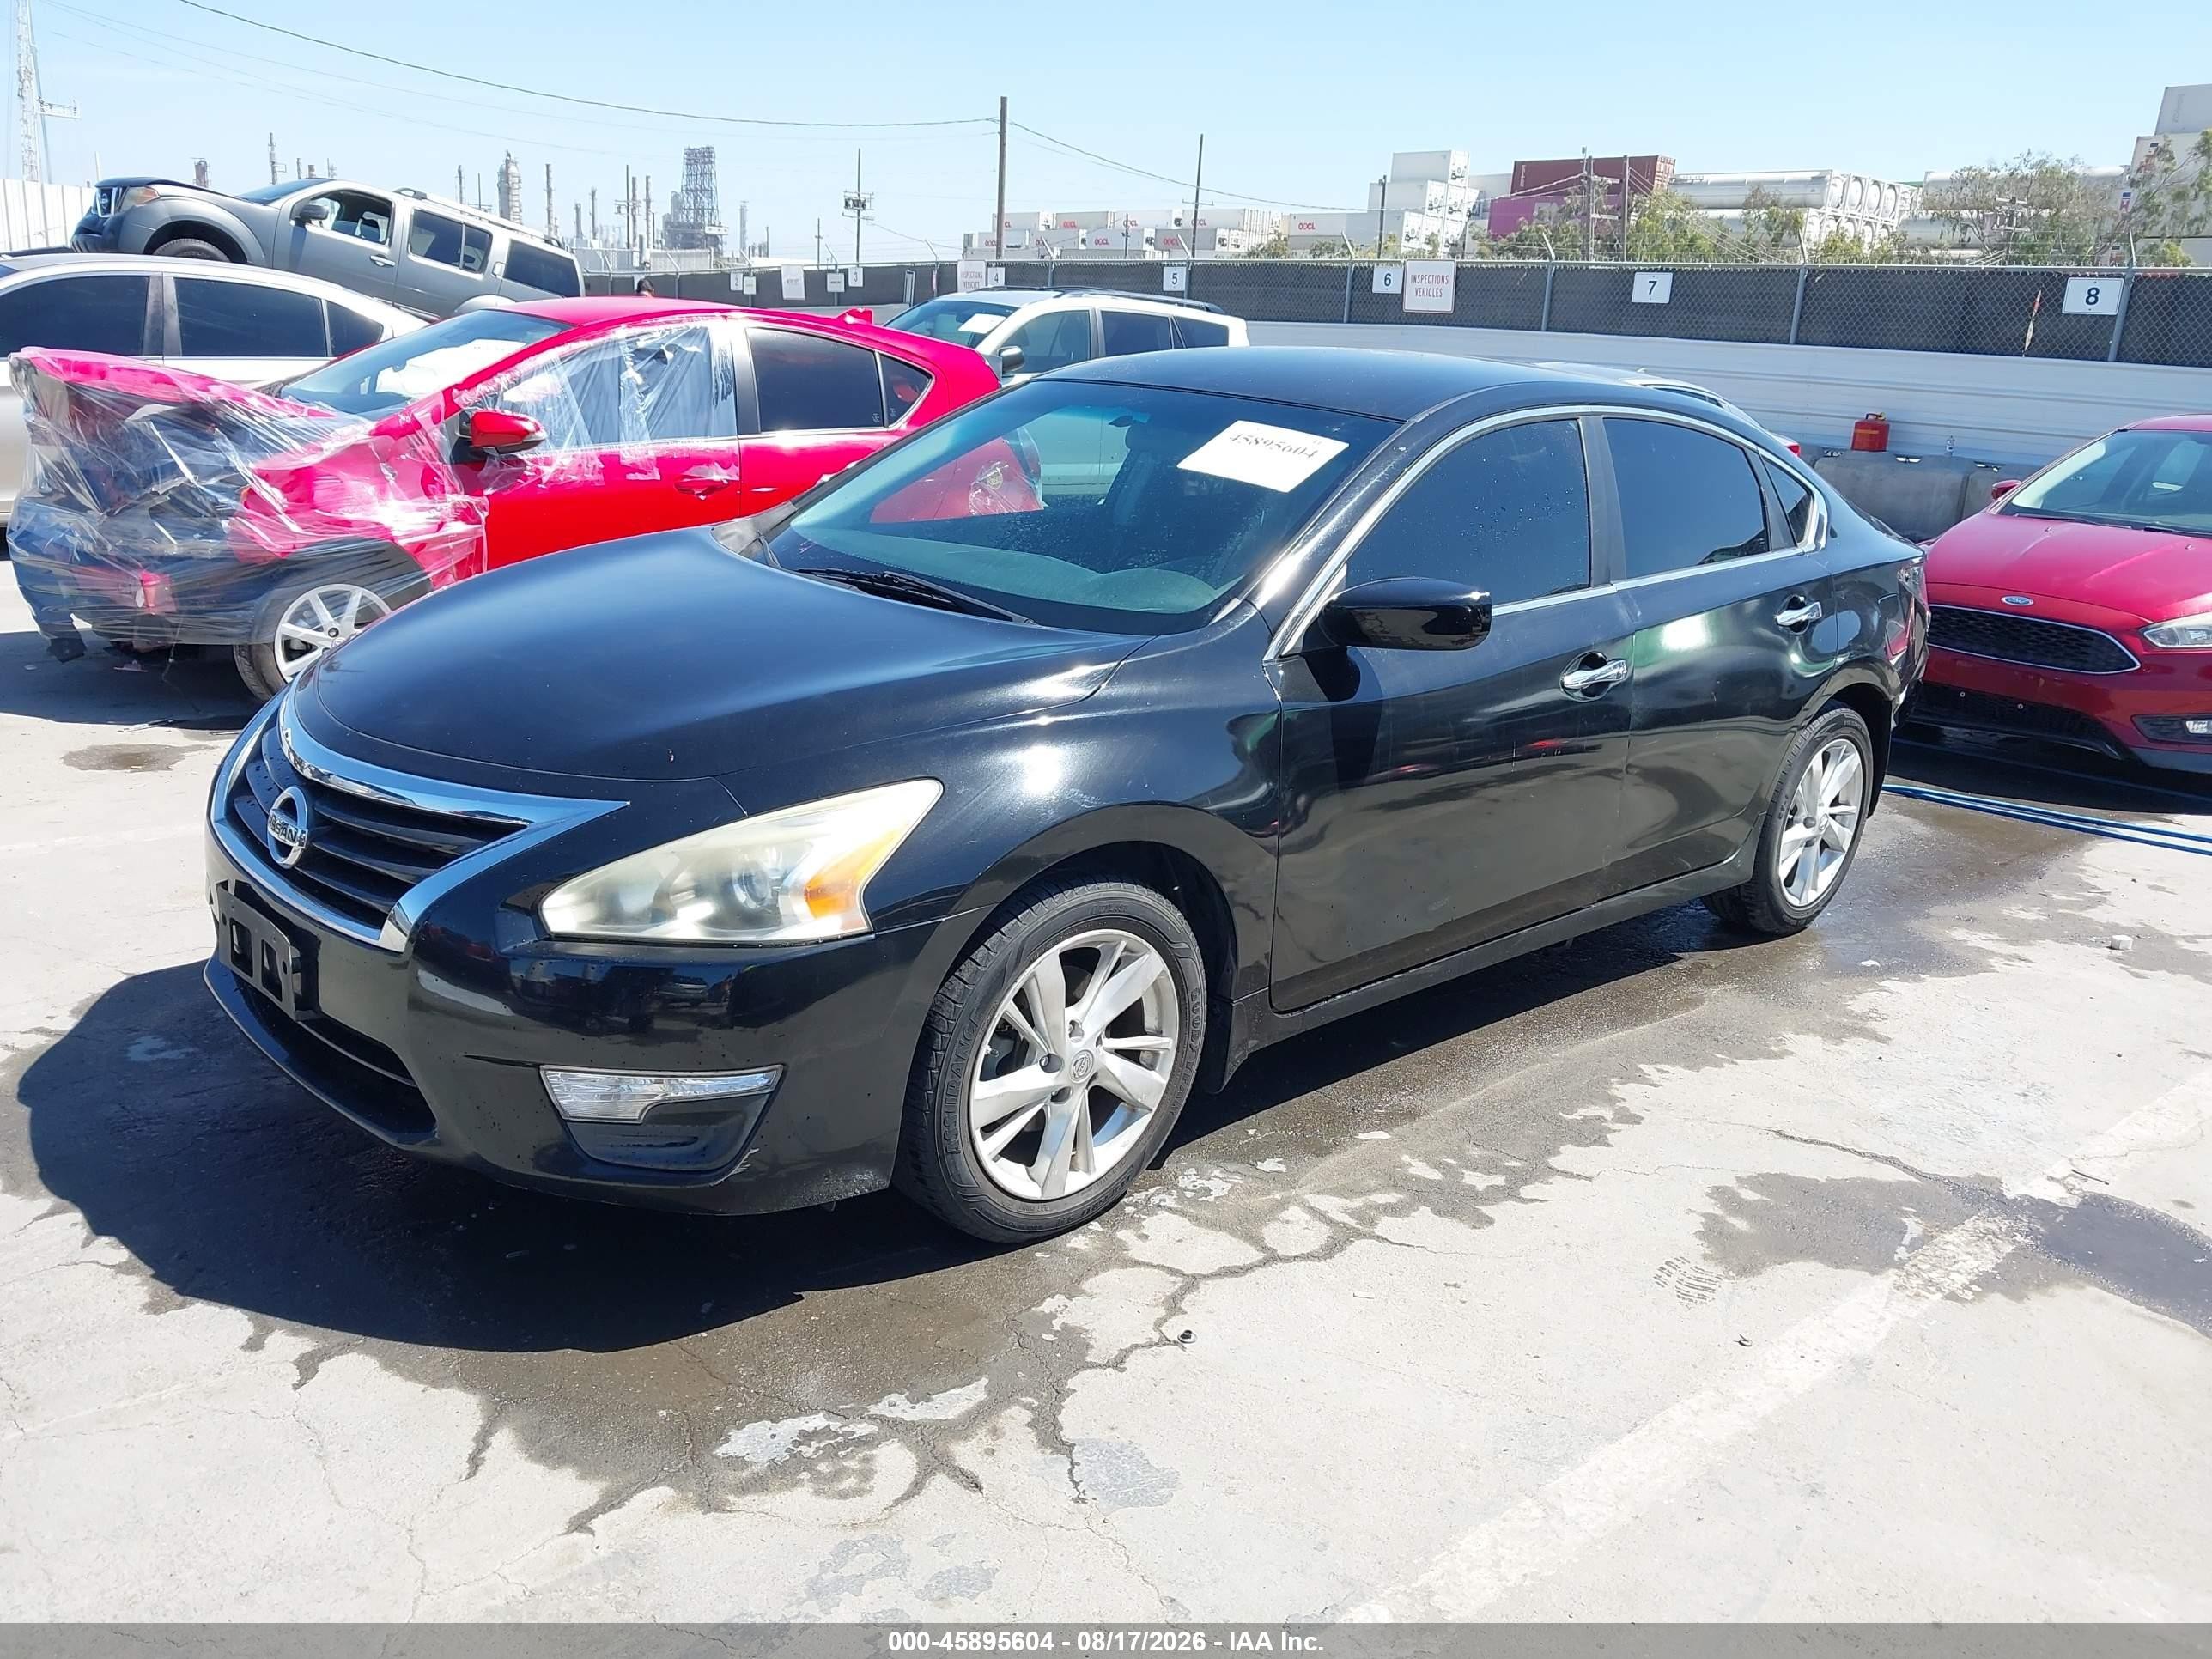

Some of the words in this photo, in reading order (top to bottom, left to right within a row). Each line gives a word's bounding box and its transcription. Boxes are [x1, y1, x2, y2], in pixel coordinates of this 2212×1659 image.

[994, 272, 999, 283] 4
[1171, 272, 1178, 284] 5
[1383, 272, 1392, 287] 6
[1410, 274, 1449, 285] INSPECTIONS
[1414, 287, 1443, 298] VEHICLES
[1648, 280, 1657, 295] 7
[2085, 287, 2100, 306] 8
